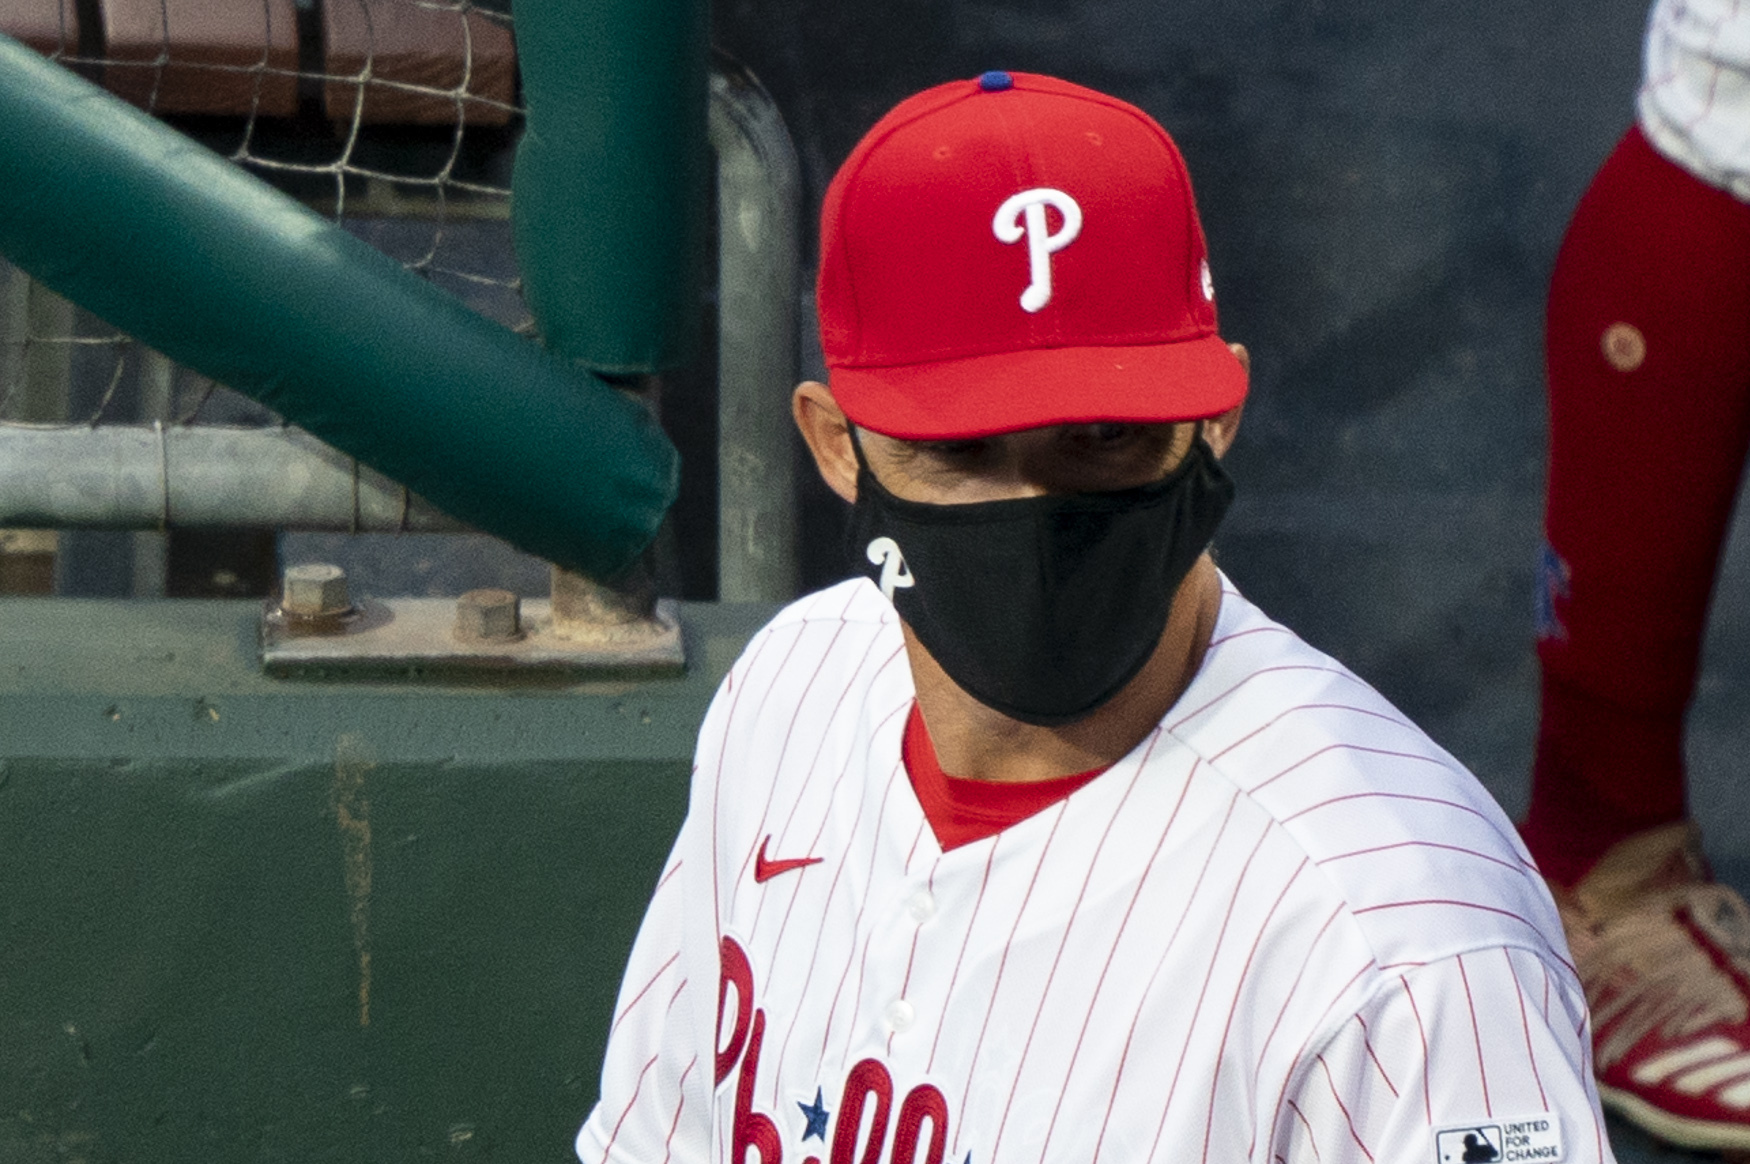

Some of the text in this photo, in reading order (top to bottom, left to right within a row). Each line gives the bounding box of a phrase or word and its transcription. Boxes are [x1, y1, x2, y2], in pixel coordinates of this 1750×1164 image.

[992, 186, 1084, 313] P
[1504, 1120, 1549, 1134] UNITED
[1506, 1135, 1530, 1147] FOR
[1506, 1146, 1558, 1161] CHANGE
